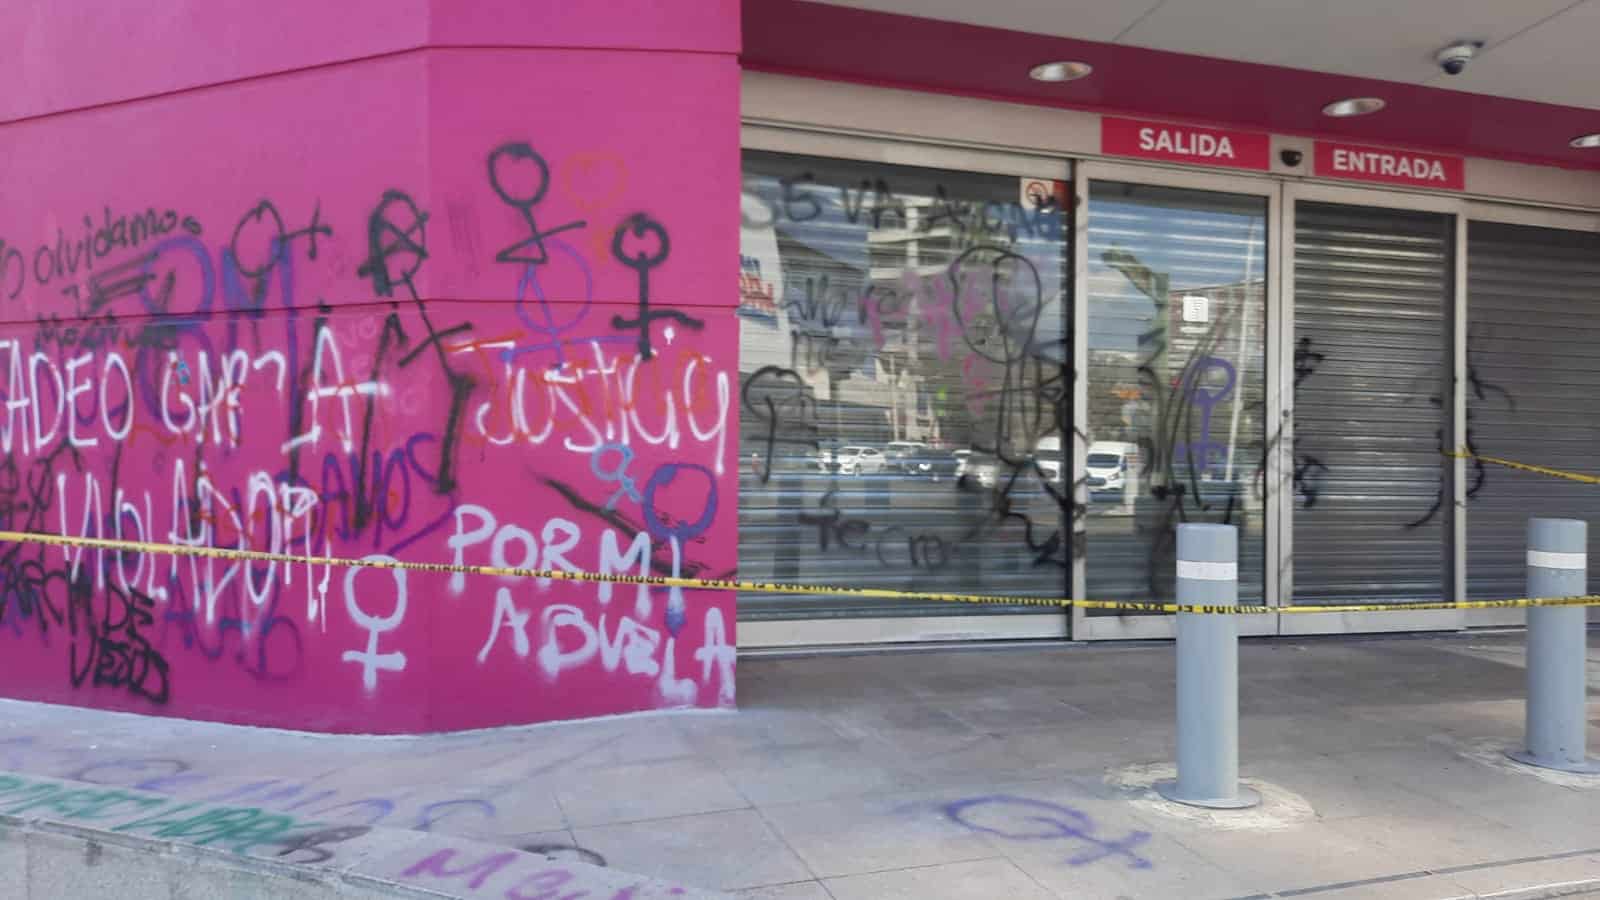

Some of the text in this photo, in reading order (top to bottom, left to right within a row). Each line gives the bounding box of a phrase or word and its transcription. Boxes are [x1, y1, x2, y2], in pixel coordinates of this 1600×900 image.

[1138, 126, 1236, 161] SALIDA
[1332, 148, 1447, 183] ENTRADA
[33, 204, 203, 286] olvidamos
[448, 502, 686, 622] POR MI
